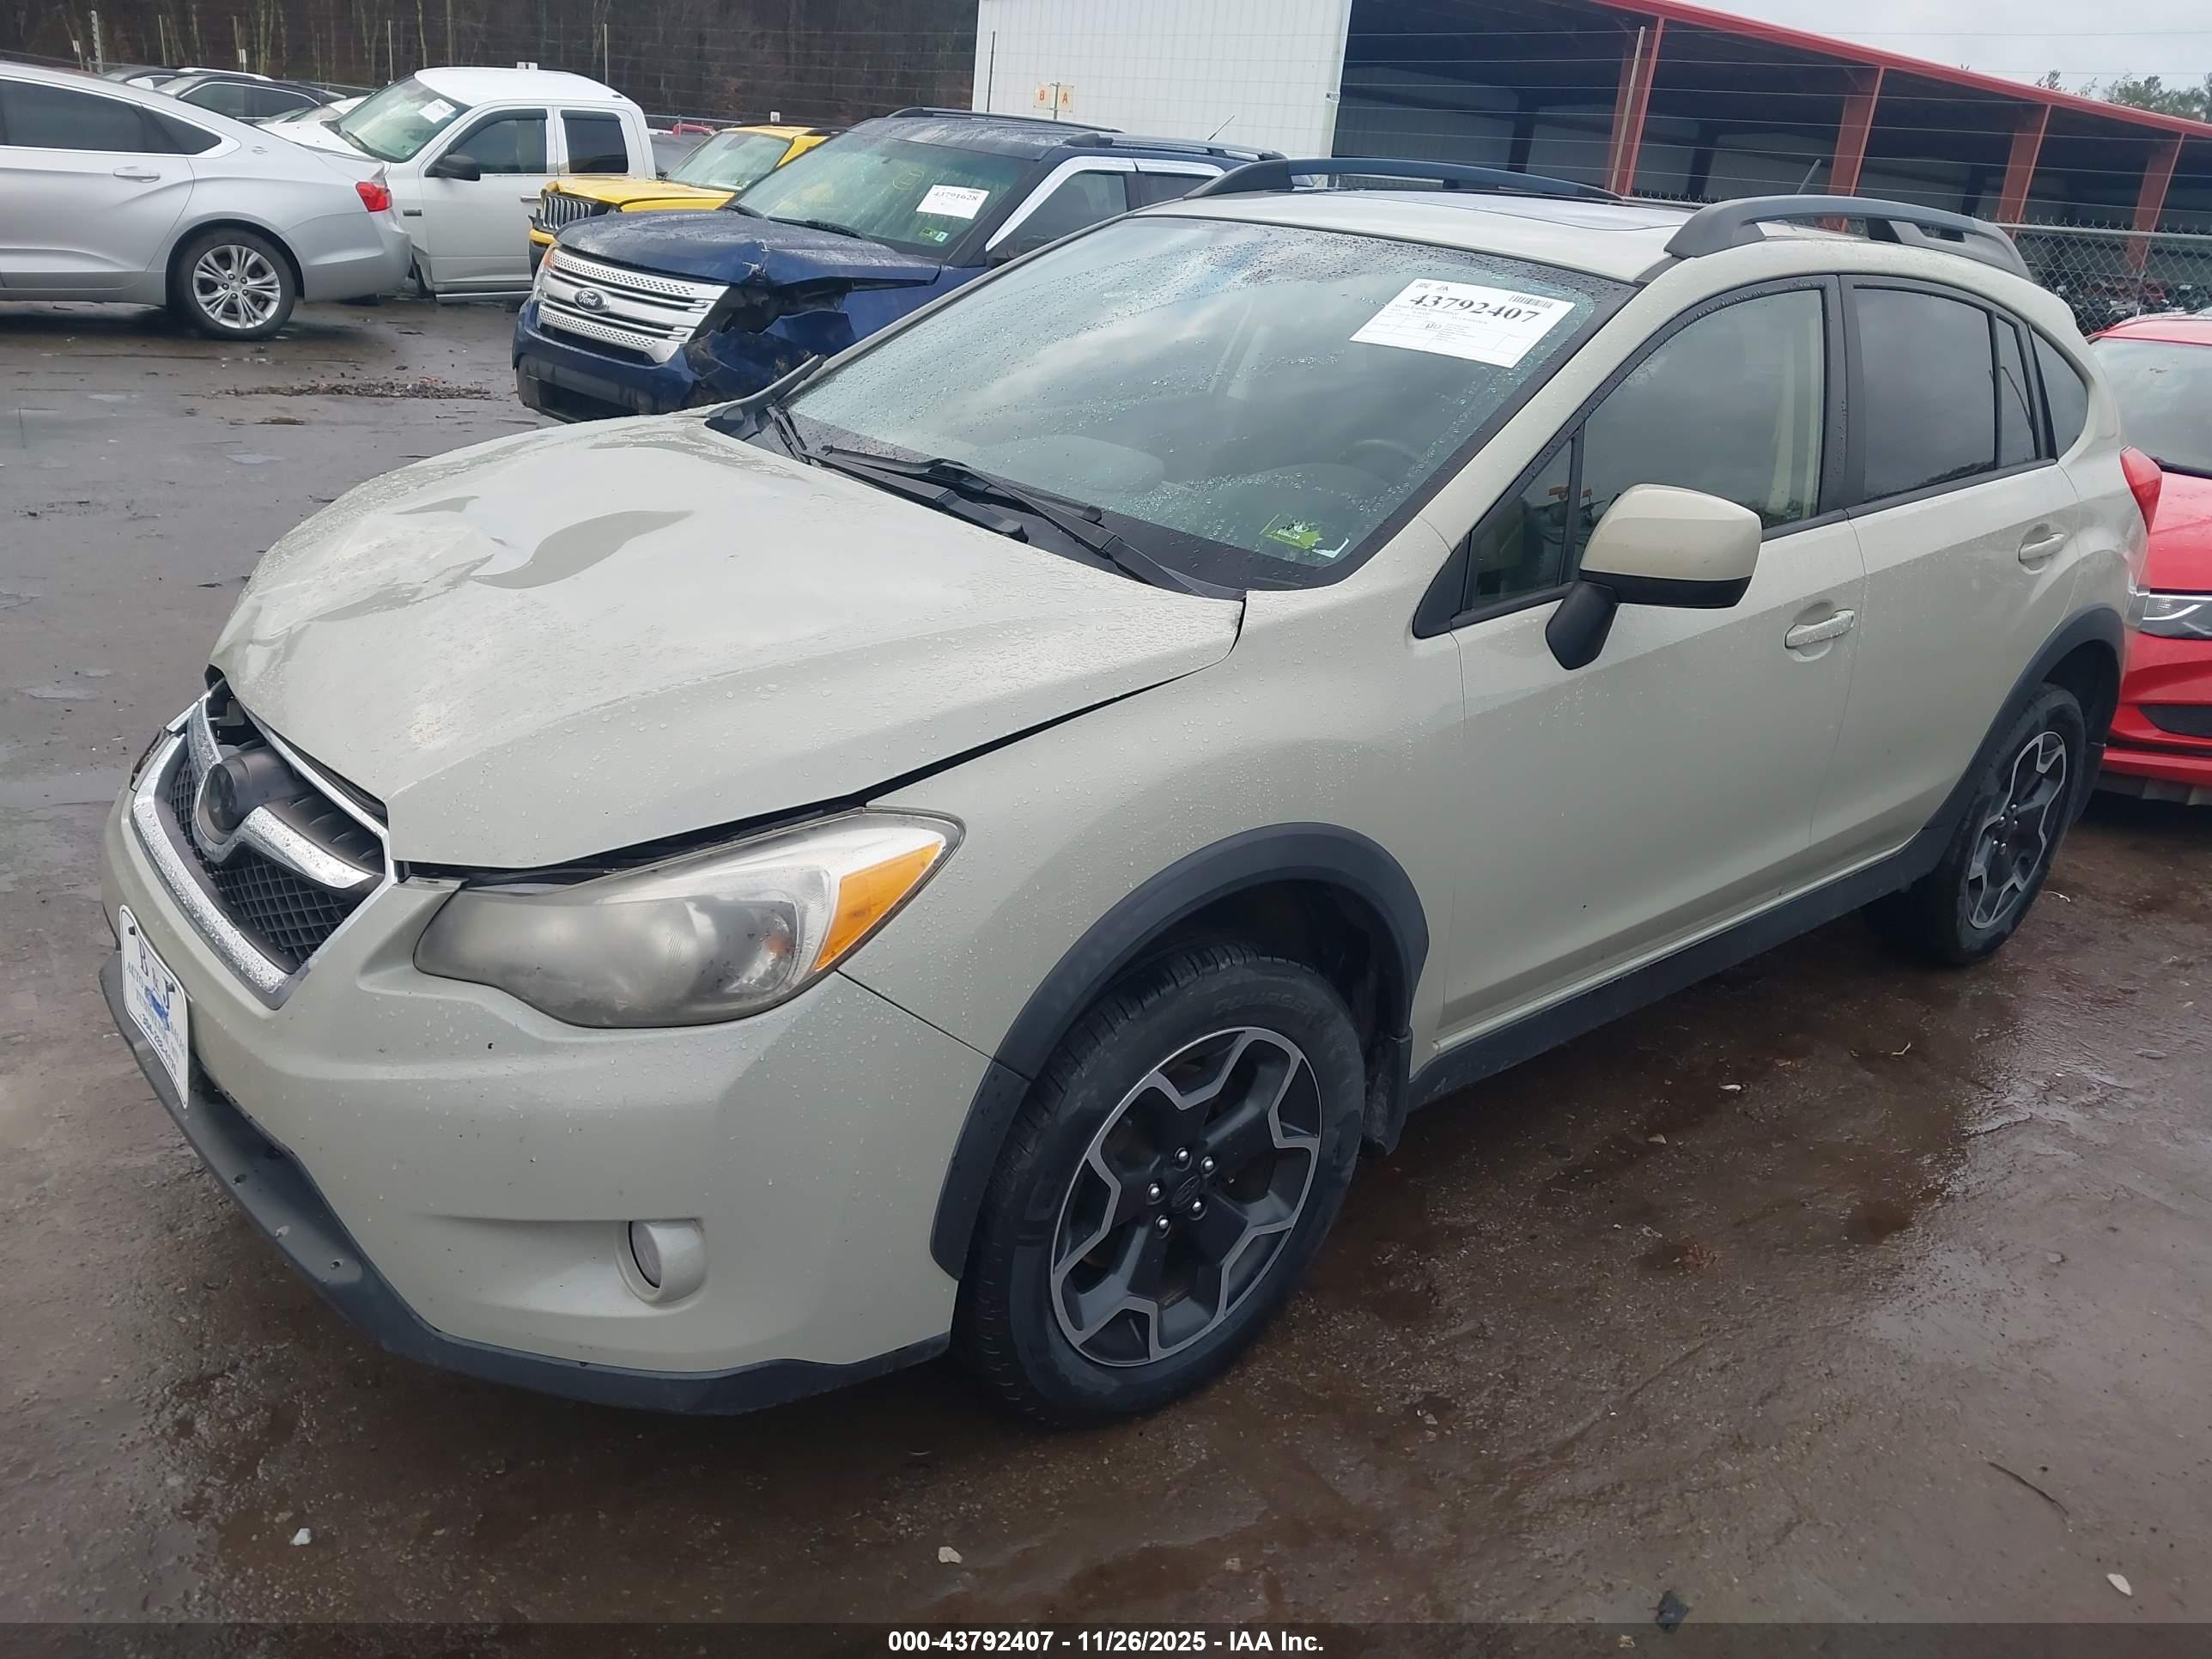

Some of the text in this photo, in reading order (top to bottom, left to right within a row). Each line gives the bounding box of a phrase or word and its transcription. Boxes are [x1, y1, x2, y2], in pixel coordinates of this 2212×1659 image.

[1062, 92, 1068, 103] A
[579, 291, 598, 307] Ford
[1410, 295, 1541, 323] 43792407
[137, 937, 149, 977] B
[162, 975, 170, 1011] J
